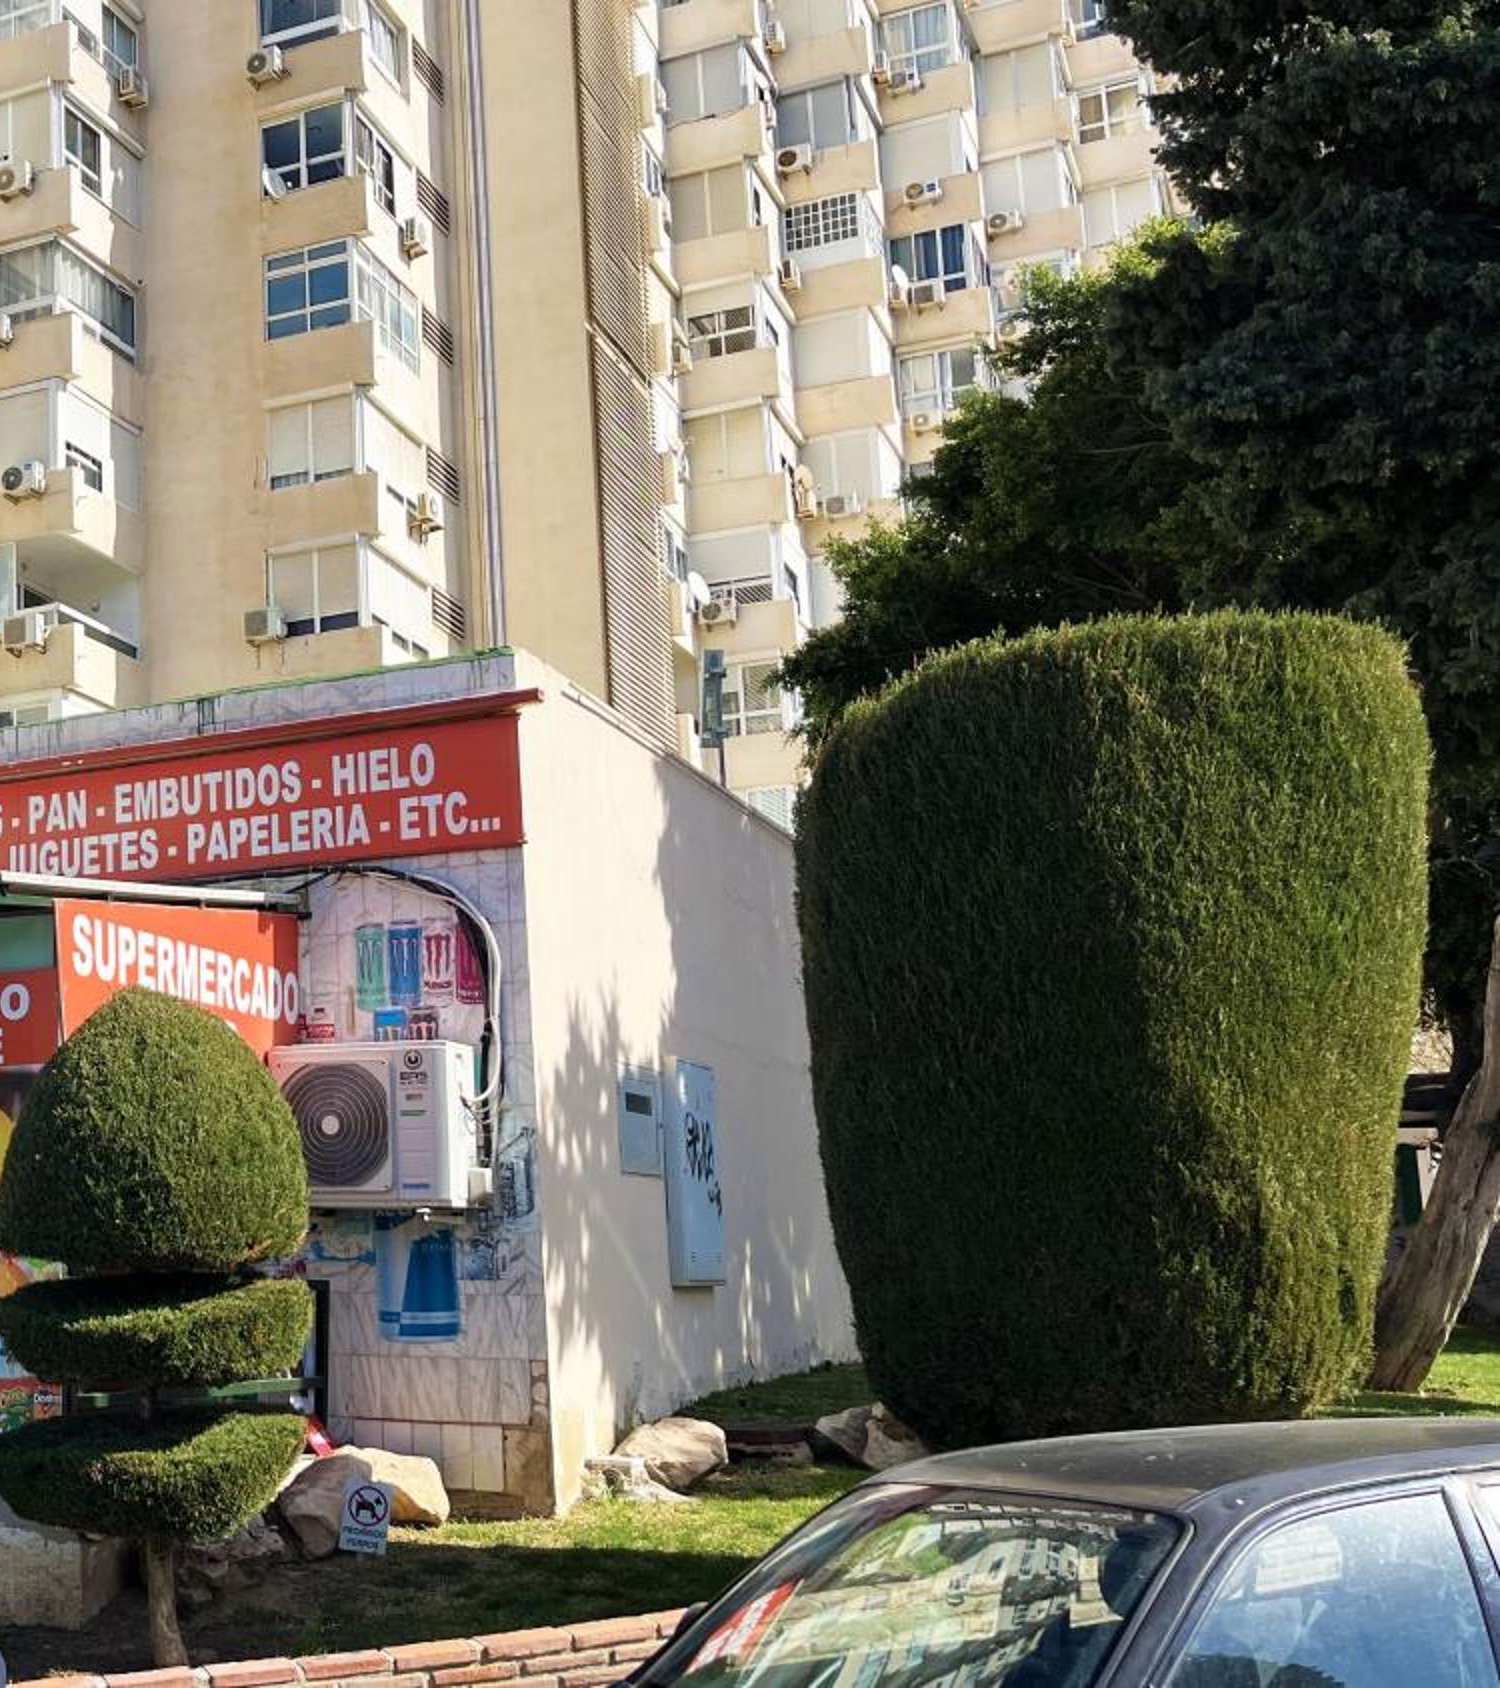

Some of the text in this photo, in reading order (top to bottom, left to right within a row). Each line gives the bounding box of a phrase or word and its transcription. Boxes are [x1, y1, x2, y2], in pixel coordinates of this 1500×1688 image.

[28, 789, 87, 835] PAN
[114, 761, 301, 824] EMBUTIDOS
[332, 743, 436, 795] HIELO
[187, 804, 370, 864] PAPELERIA
[400, 792, 501, 841] ETC...
[72, 914, 299, 1024] SUPERMERCADO
